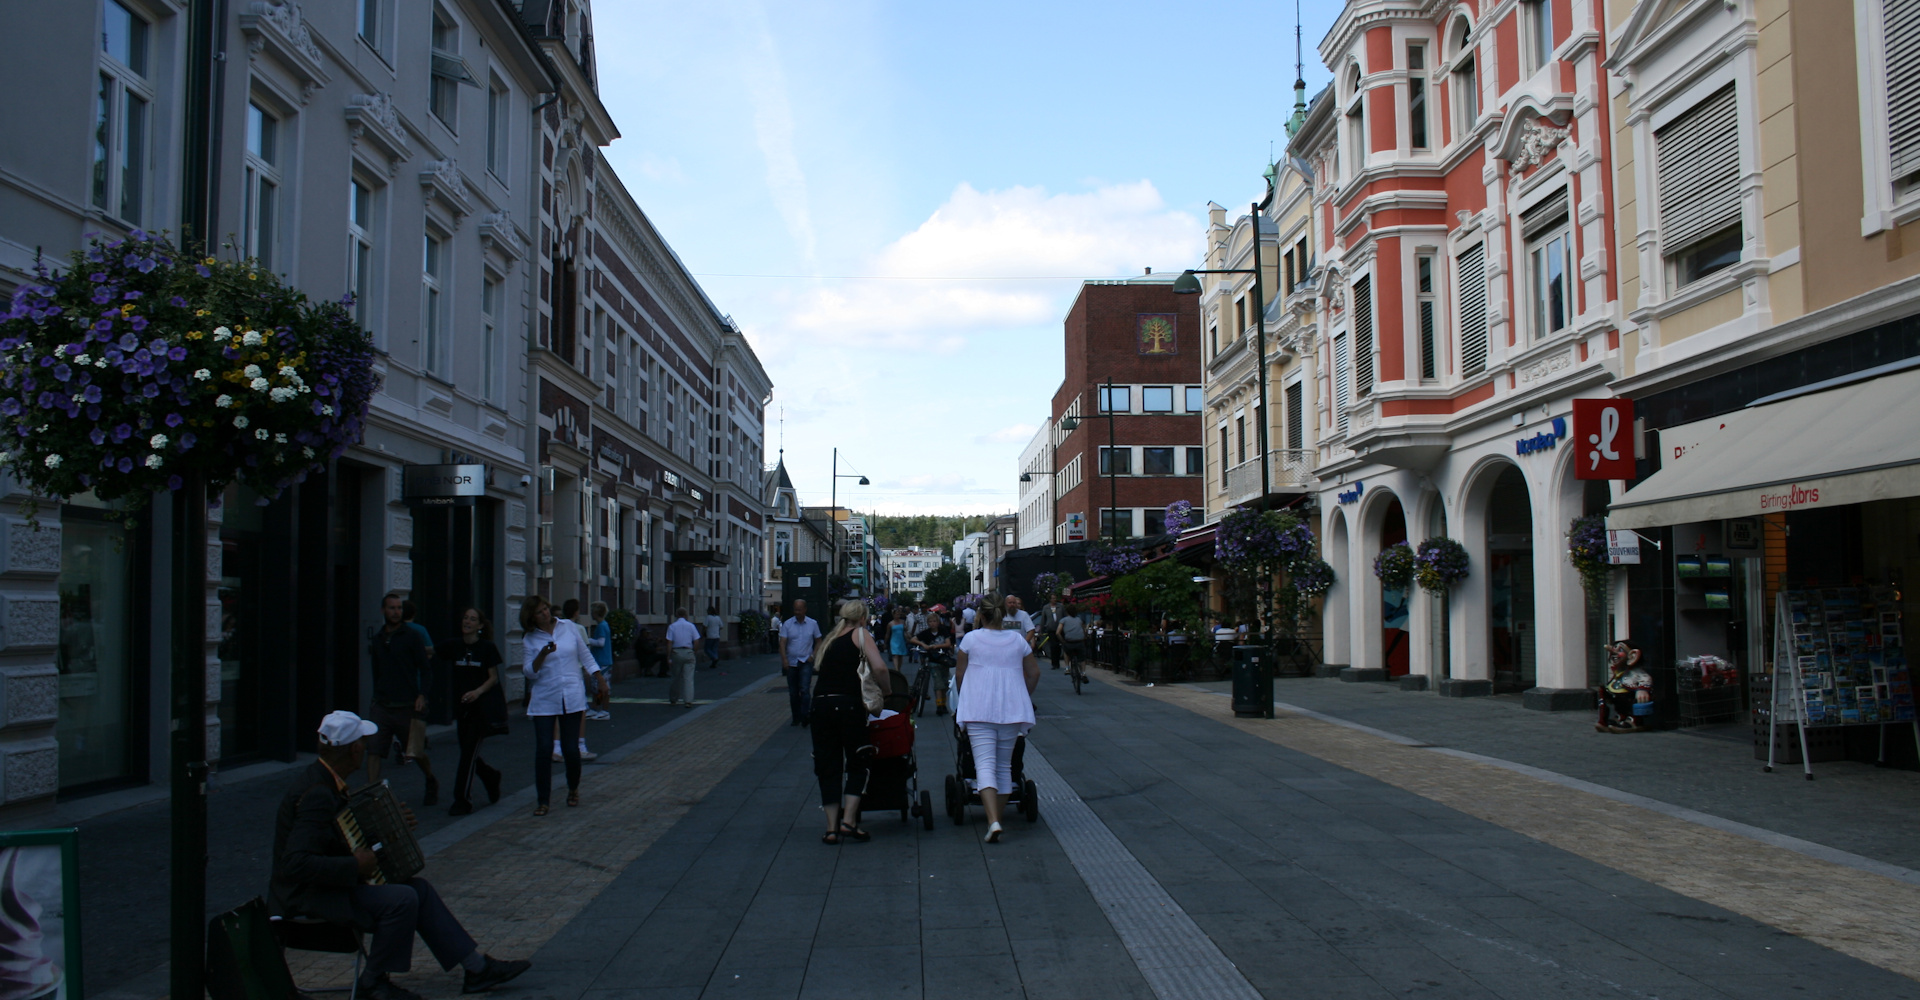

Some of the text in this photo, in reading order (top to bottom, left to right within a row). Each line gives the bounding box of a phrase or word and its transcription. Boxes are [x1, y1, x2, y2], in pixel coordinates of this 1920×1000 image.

[1516, 431, 1556, 456] Nordea
[443, 475, 472, 485] NOR
[422, 497, 455, 505] Minibank
[1608, 546, 1639, 556] SOUVENIRS
